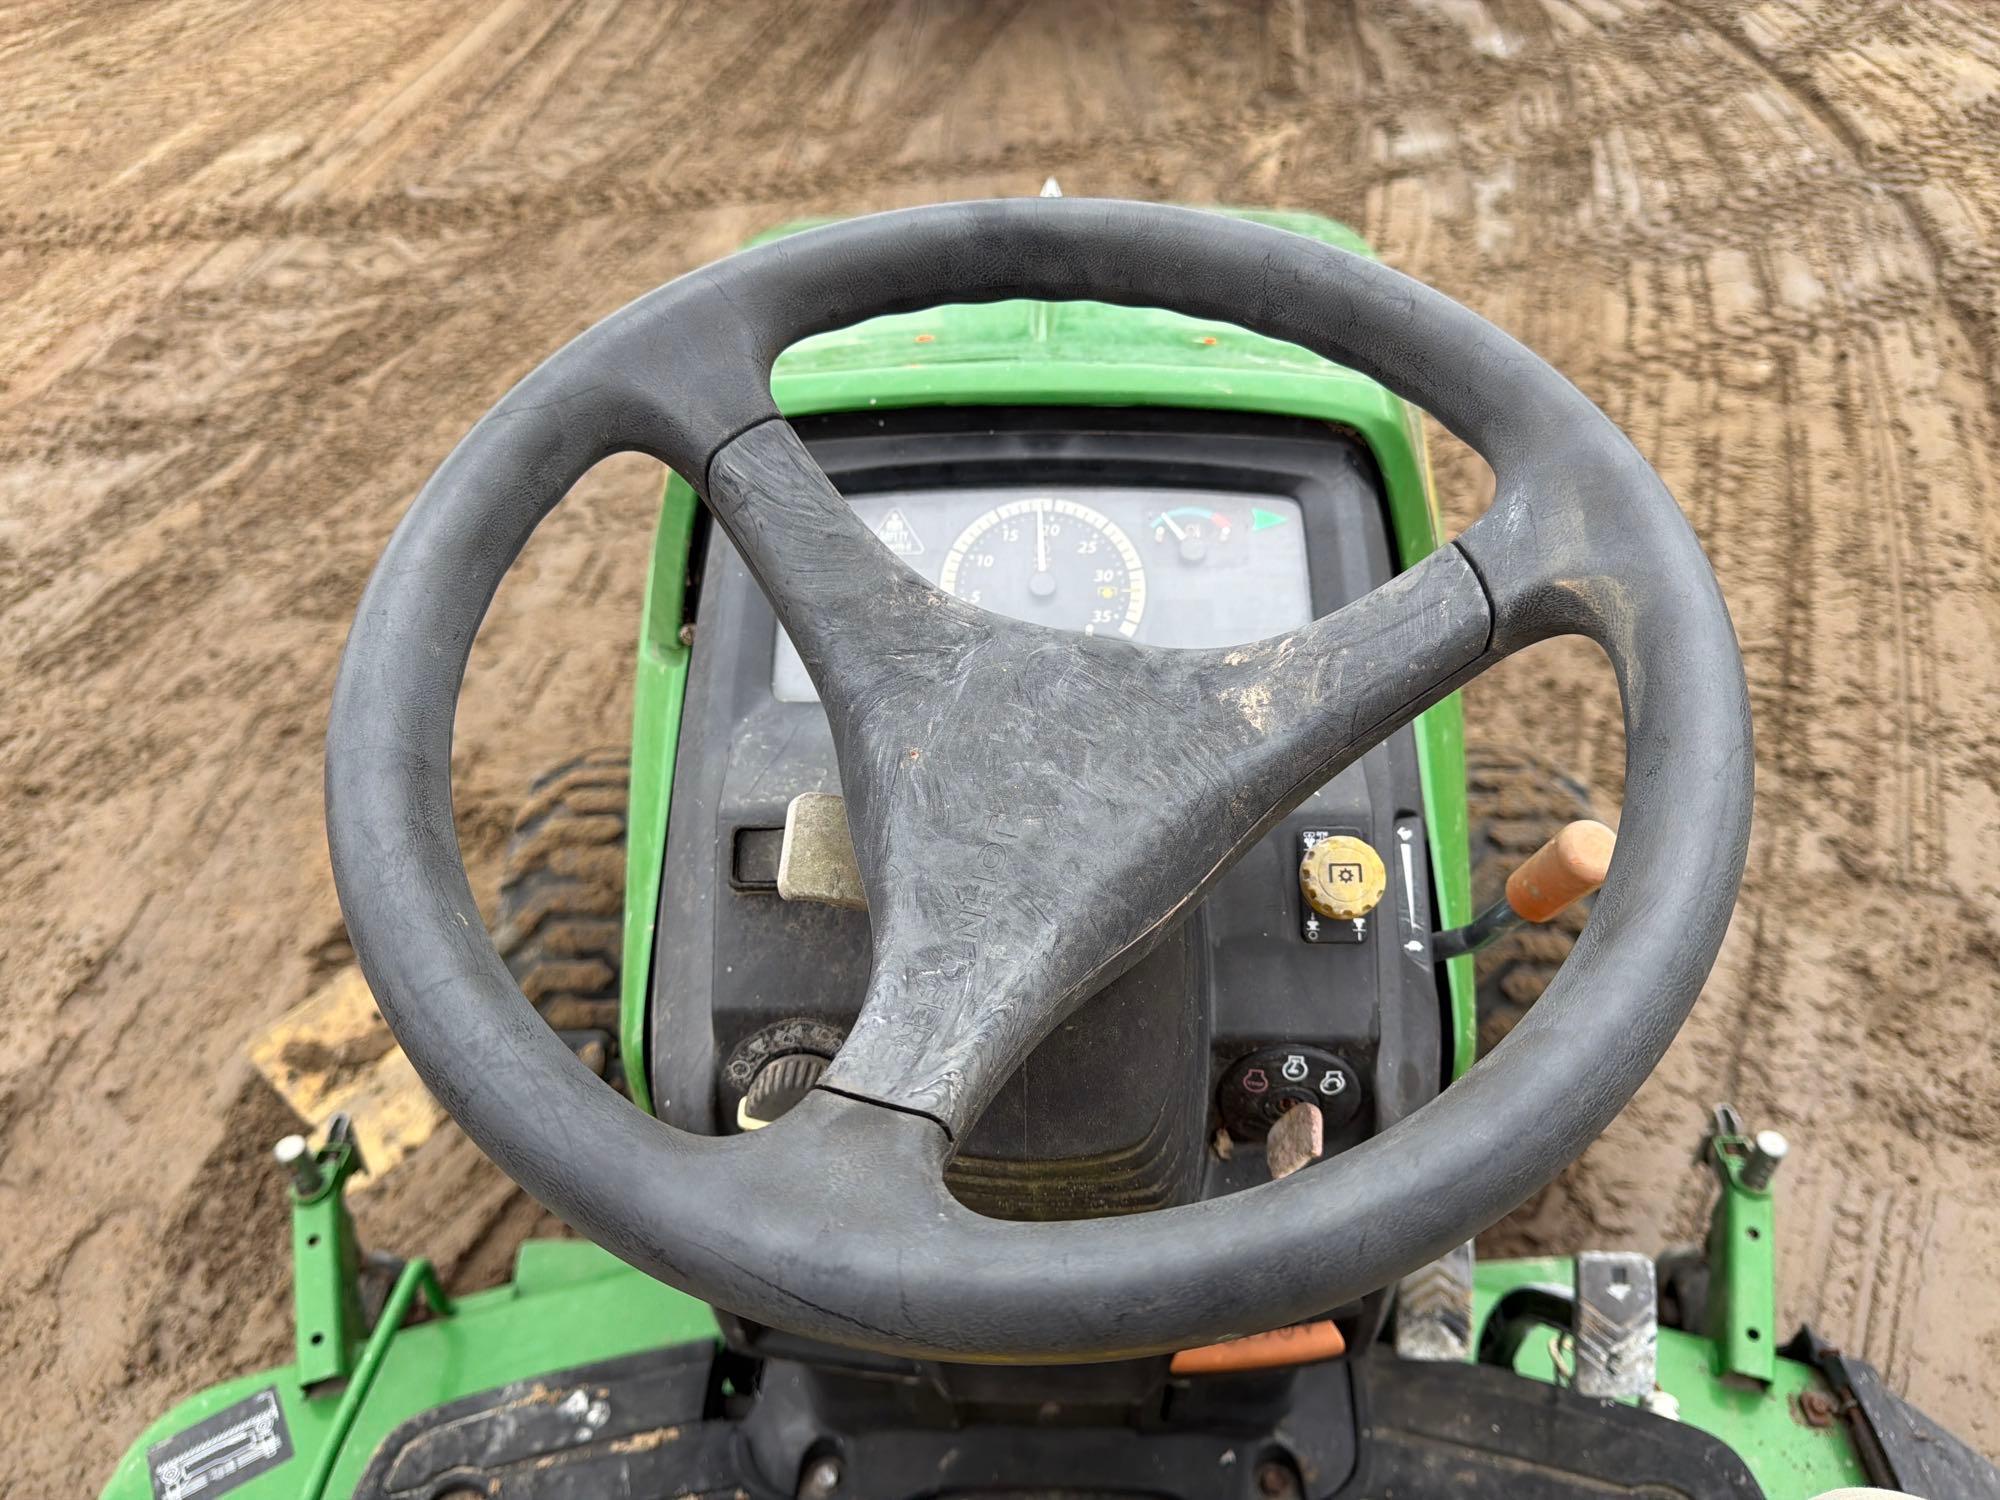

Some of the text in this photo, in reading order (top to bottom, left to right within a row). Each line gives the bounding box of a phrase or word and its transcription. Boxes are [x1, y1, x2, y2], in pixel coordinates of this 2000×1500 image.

[1002, 528, 1019, 542] 15
[1077, 541, 1097, 554] 25
[977, 554, 994, 567] 10
[1092, 568, 1114, 582] 30
[970, 590, 981, 604] 5
[1091, 609, 1113, 623] 35
